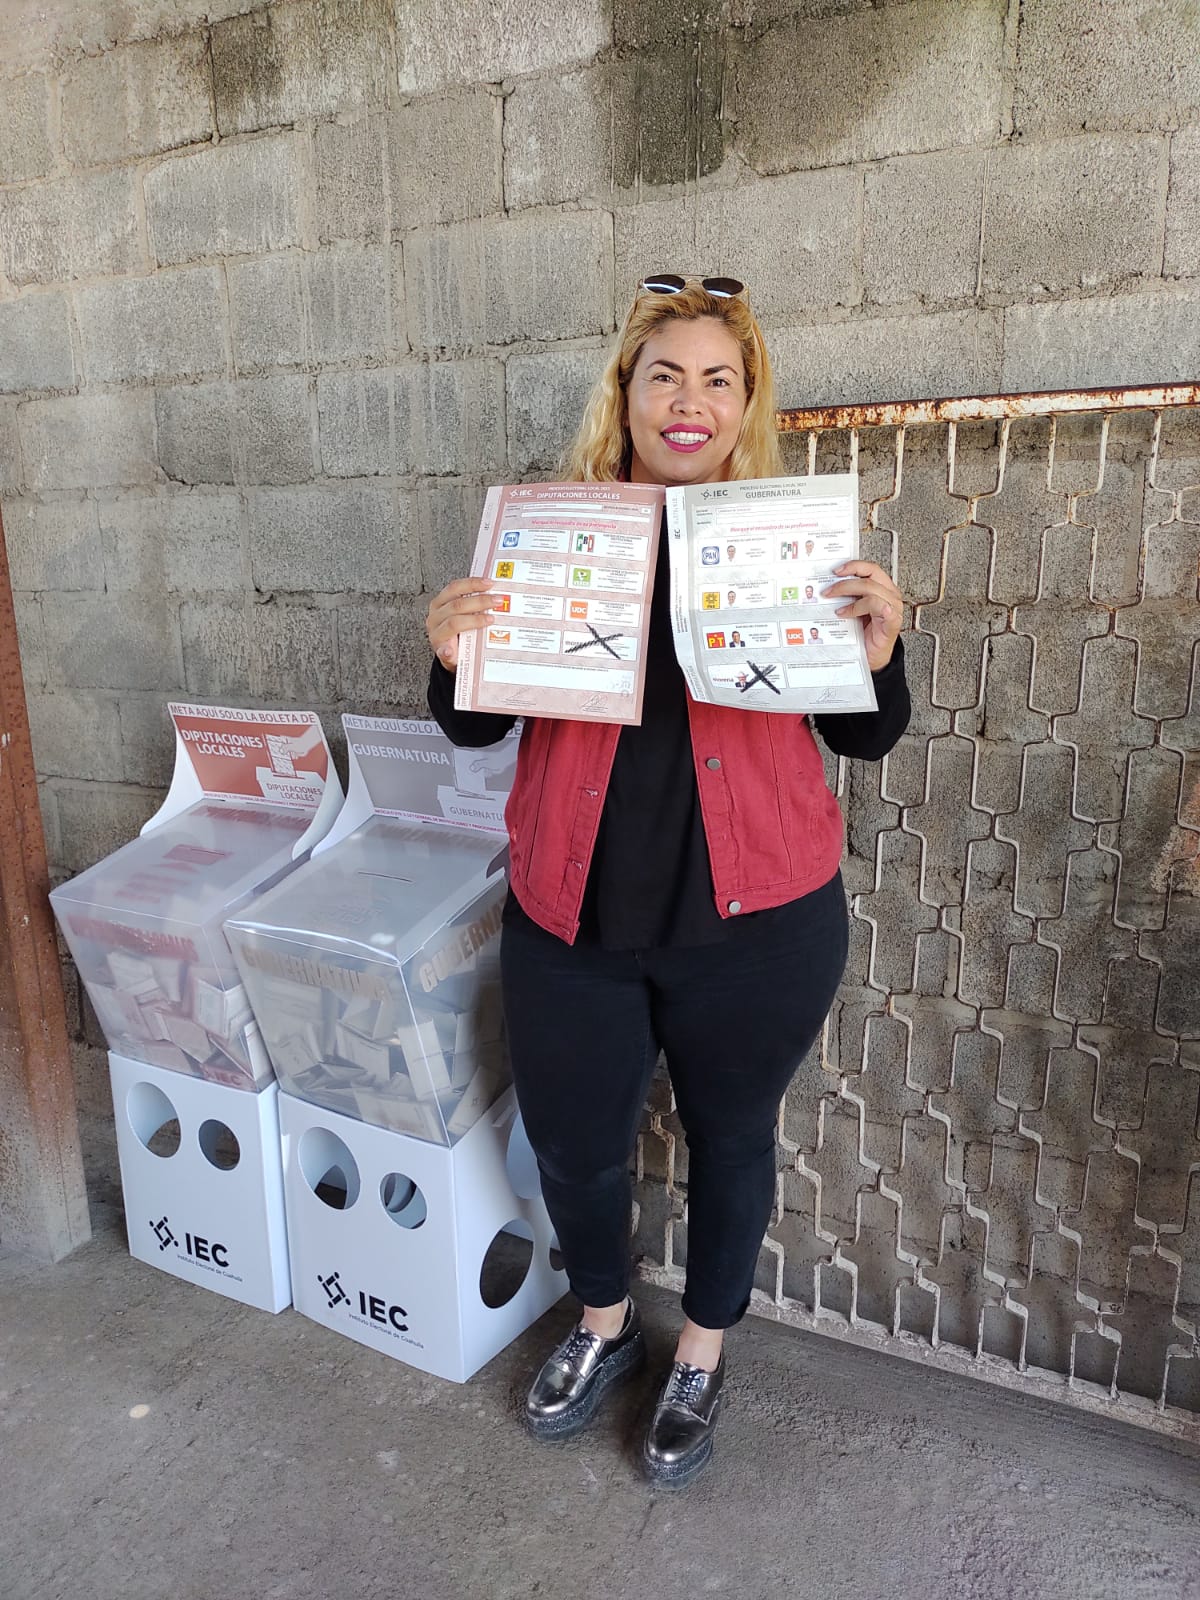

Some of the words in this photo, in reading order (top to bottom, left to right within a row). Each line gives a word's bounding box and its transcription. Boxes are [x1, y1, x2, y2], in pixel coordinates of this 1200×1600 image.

[536, 491, 588, 499] DIPUTACIONES
[588, 492, 621, 500] LOCALES
[713, 489, 729, 498] IEC
[745, 489, 801, 499] GUBERNATURA
[704, 551, 717, 560] PAN
[572, 607, 587, 615] UDC
[708, 637, 724, 648] PT
[787, 633, 803, 641] UDC
[170, 705, 195, 715] META
[196, 707, 218, 719] AQUÍ
[219, 709, 243, 720] SOLO
[246, 712, 257, 722] LA
[258, 713, 298, 723] BOLETA
[300, 714, 316, 723] DE
[344, 717, 372, 729] META
[374, 719, 400, 732] AQUÍ
[403, 722, 433, 734] SOLO
[436, 724, 445, 735] L
[181, 730, 263, 748] DIPUTACIONES
[196, 743, 246, 758] LOCALES
[353, 743, 450, 765] GUBERNATURA
[266, 783, 323, 795] DIPUTACIONES
[281, 792, 314, 801] LOCALES
[450, 805, 504, 822] GUBERNATU
[185, 1232, 230, 1268] IEC
[359, 1290, 409, 1332] IEC
